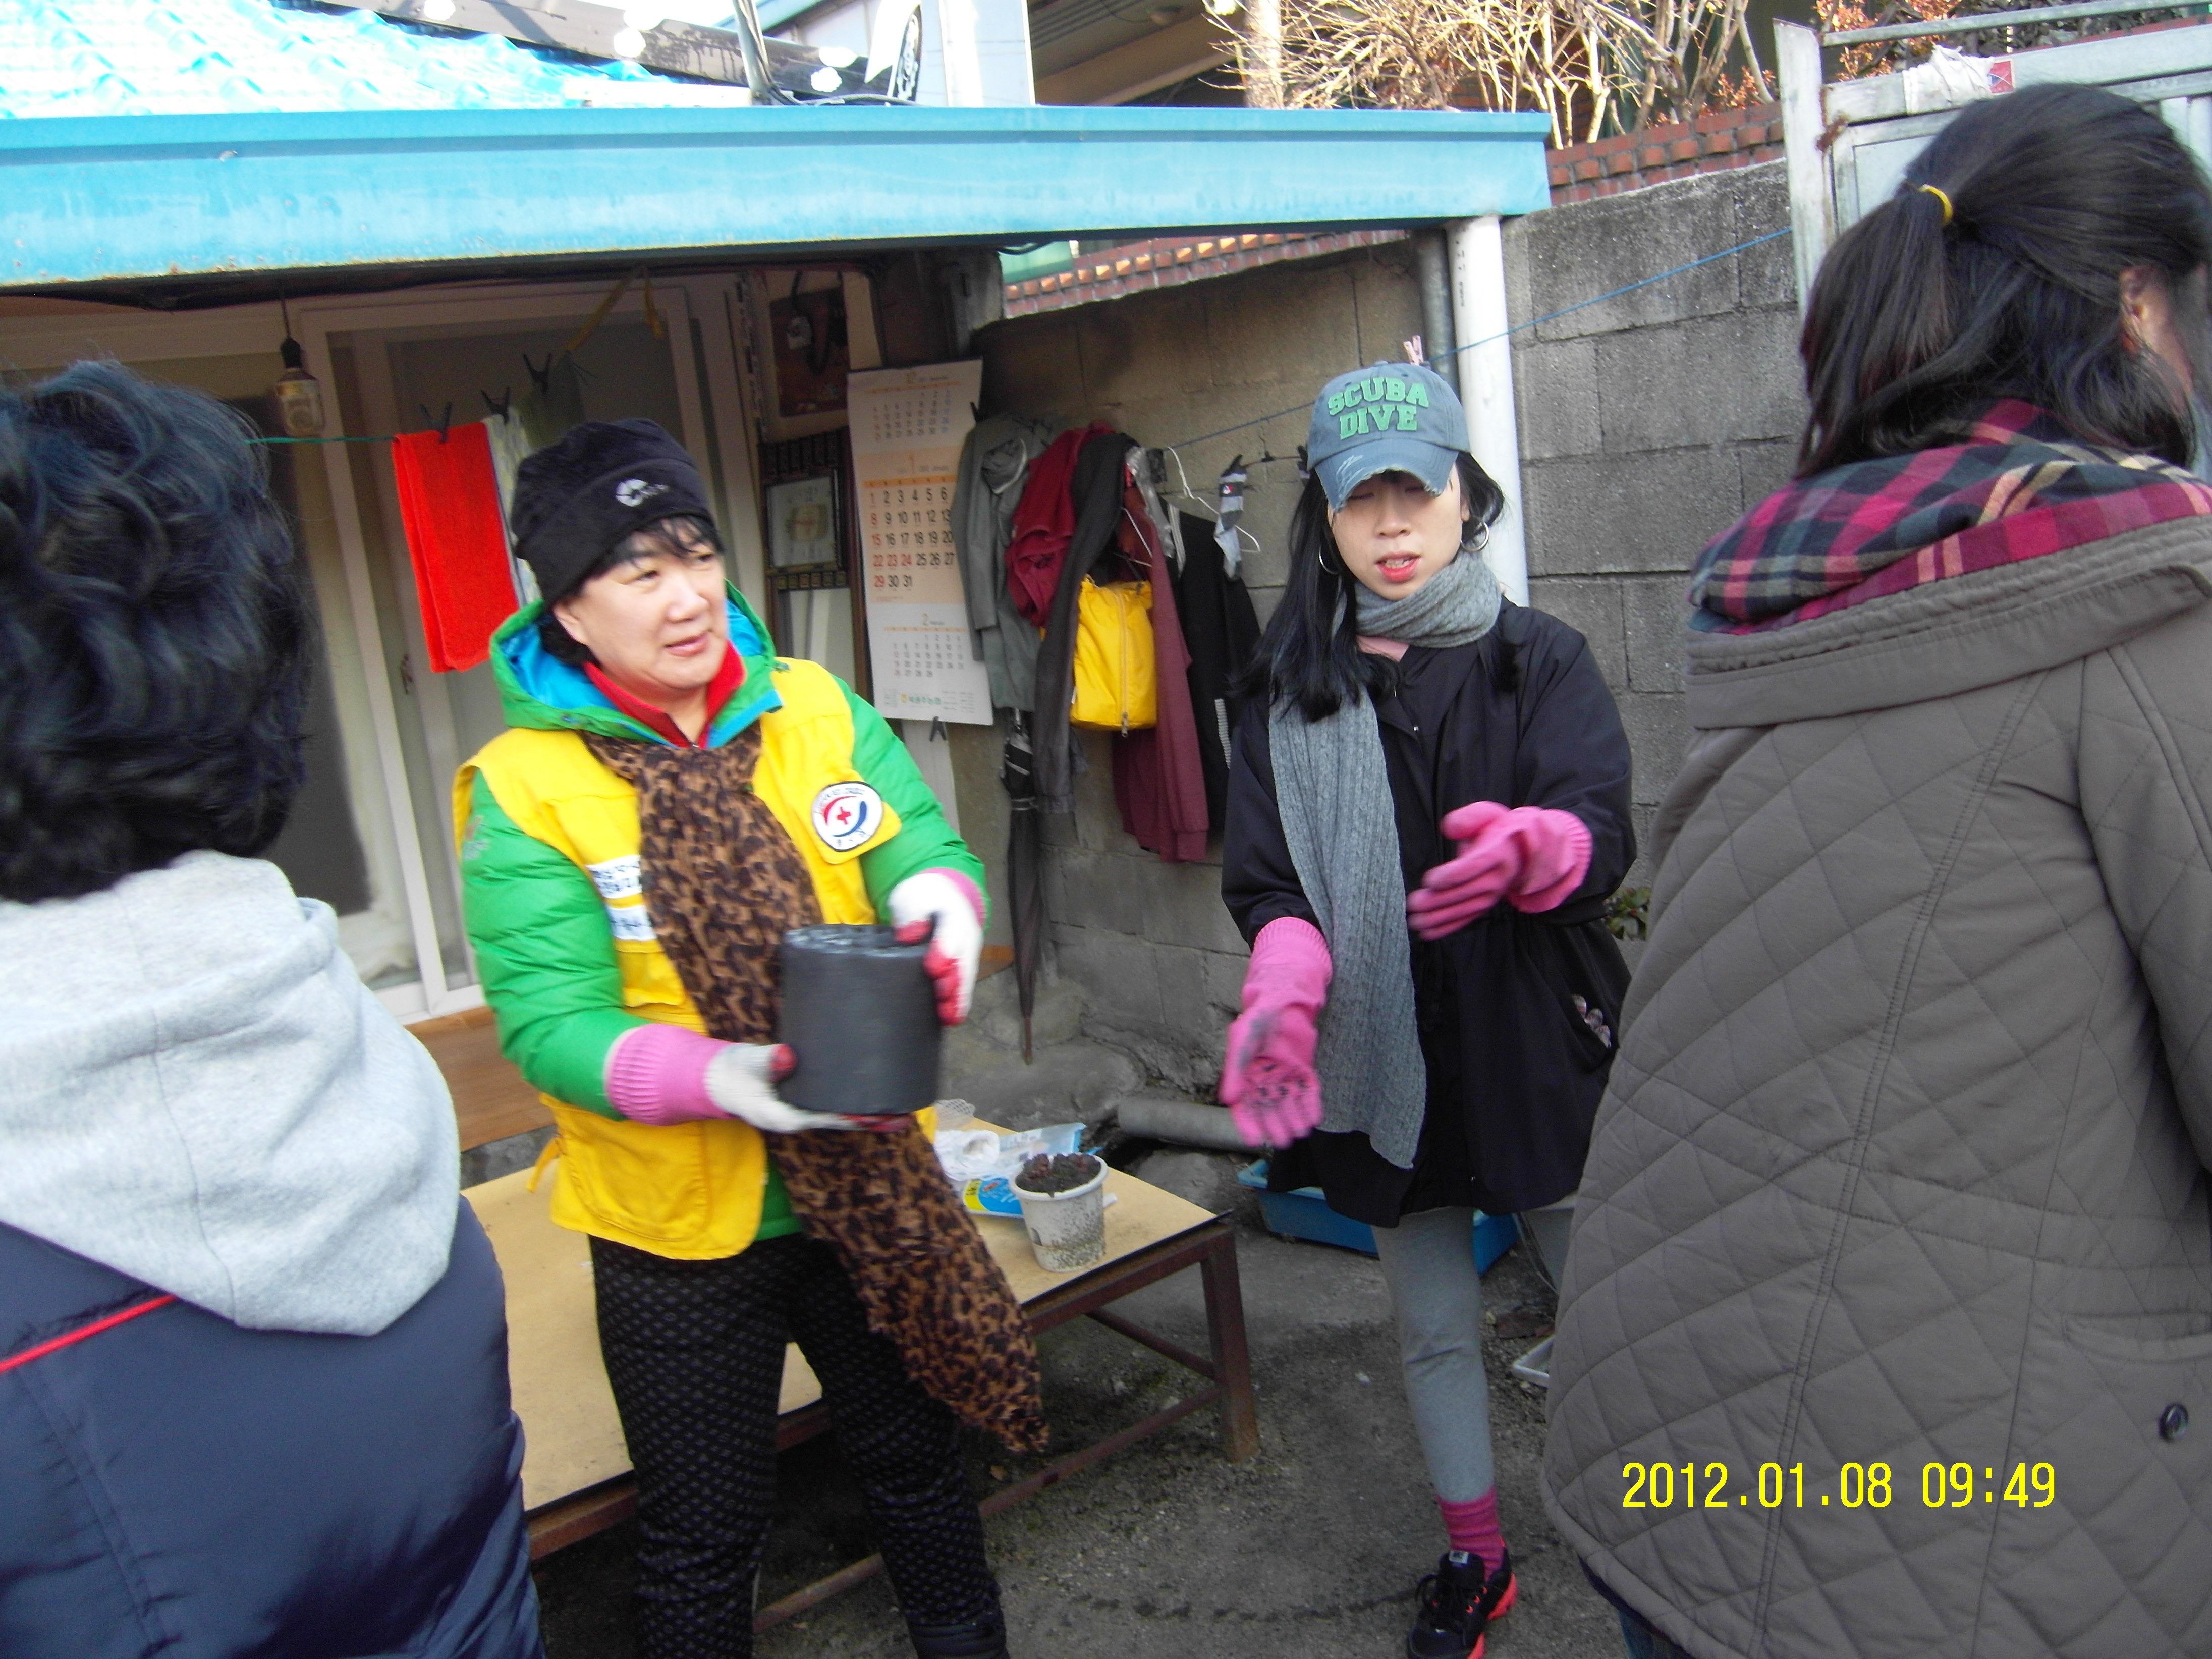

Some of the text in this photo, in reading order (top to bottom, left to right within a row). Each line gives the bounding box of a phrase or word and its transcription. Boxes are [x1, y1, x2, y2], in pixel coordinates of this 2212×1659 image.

[1328, 377, 1429, 415] SCUBA
[1340, 404, 1417, 439] DIVE
[883, 490, 890, 504] 2
[898, 490, 904, 503] 3
[912, 489, 918, 500] 4
[926, 488, 932, 501] 5
[941, 487, 948, 500] 6
[871, 509, 951, 525] 8 9 10 11 12 13
[872, 531, 953, 545] 15 16 17 18 19 20
[873, 552, 954, 566] 22 23 24 25 26 27
[874, 575, 913, 587] 29 30 31
